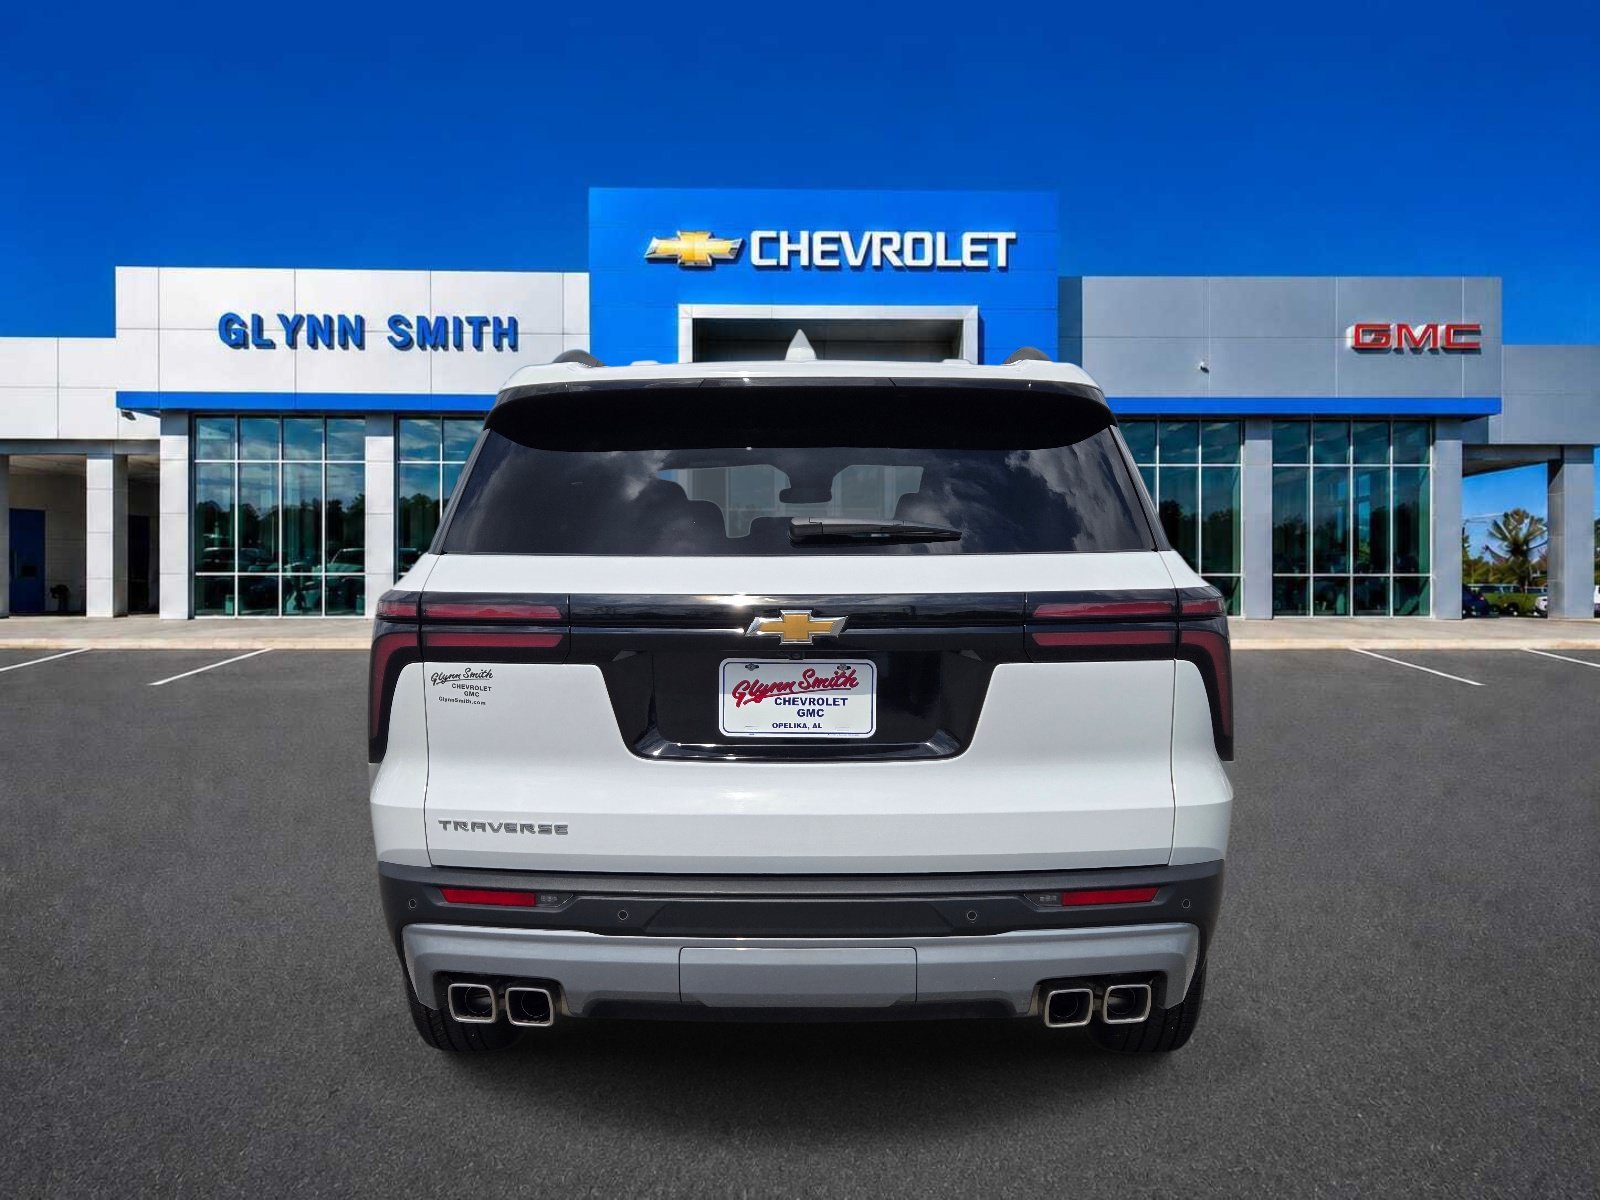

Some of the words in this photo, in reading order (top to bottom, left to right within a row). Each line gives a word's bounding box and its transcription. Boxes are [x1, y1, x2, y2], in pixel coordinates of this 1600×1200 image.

[750, 230, 1017, 269] CHEVROLET
[218, 312, 365, 350] GLYNN
[387, 314, 518, 352] SMITH
[1350, 322, 1482, 352] GMC
[431, 672, 461, 686] Glynn
[463, 667, 493, 679] Smith
[451, 683, 492, 692] CHEVROLET
[731, 679, 796, 708] Glynn
[798, 668, 859, 689] Smith
[463, 690, 480, 698] GMC
[438, 696, 486, 705] GlynnSmith.com
[774, 697, 848, 707] CHEVROLET
[796, 708, 825, 718] GMC
[771, 722, 810, 731] OPELIKA,
[812, 722, 823, 730] AL
[438, 820, 569, 835] TRAVERSE
